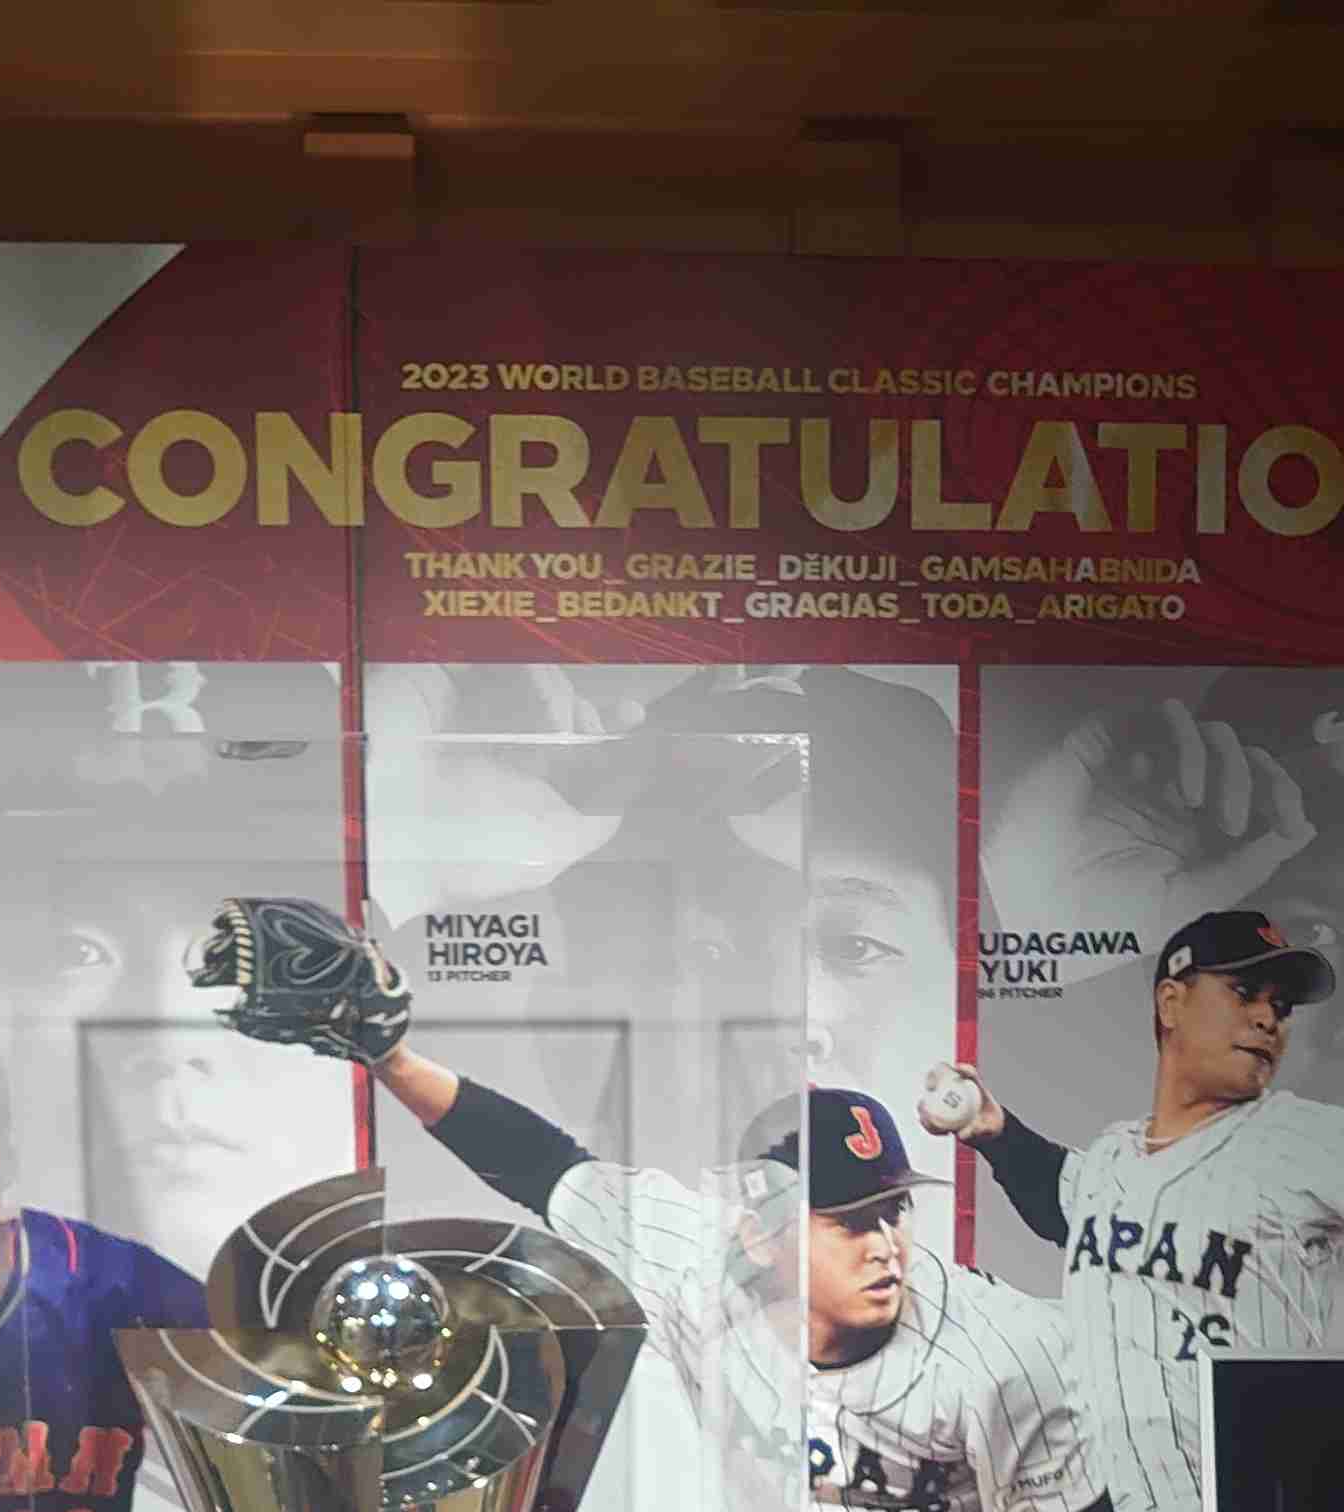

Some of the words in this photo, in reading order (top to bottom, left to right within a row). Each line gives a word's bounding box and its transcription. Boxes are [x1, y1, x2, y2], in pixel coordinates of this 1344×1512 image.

[400, 362, 489, 390] 2023
[497, 364, 629, 392] WORLD
[637, 365, 824, 395] BASEBALL
[828, 367, 976, 397] CLASSIC
[986, 370, 1198, 401] CHAMPIONS
[403, 552, 524, 578] THANK
[425, 914, 540, 939] MIYAGI
[428, 942, 549, 967] HIROYA
[978, 930, 1142, 956] UDAGAWA
[427, 969, 442, 983] 13
[446, 969, 512, 983] PITCHER
[979, 959, 1058, 983] YUKI
[843, 1105, 883, 1161] J
